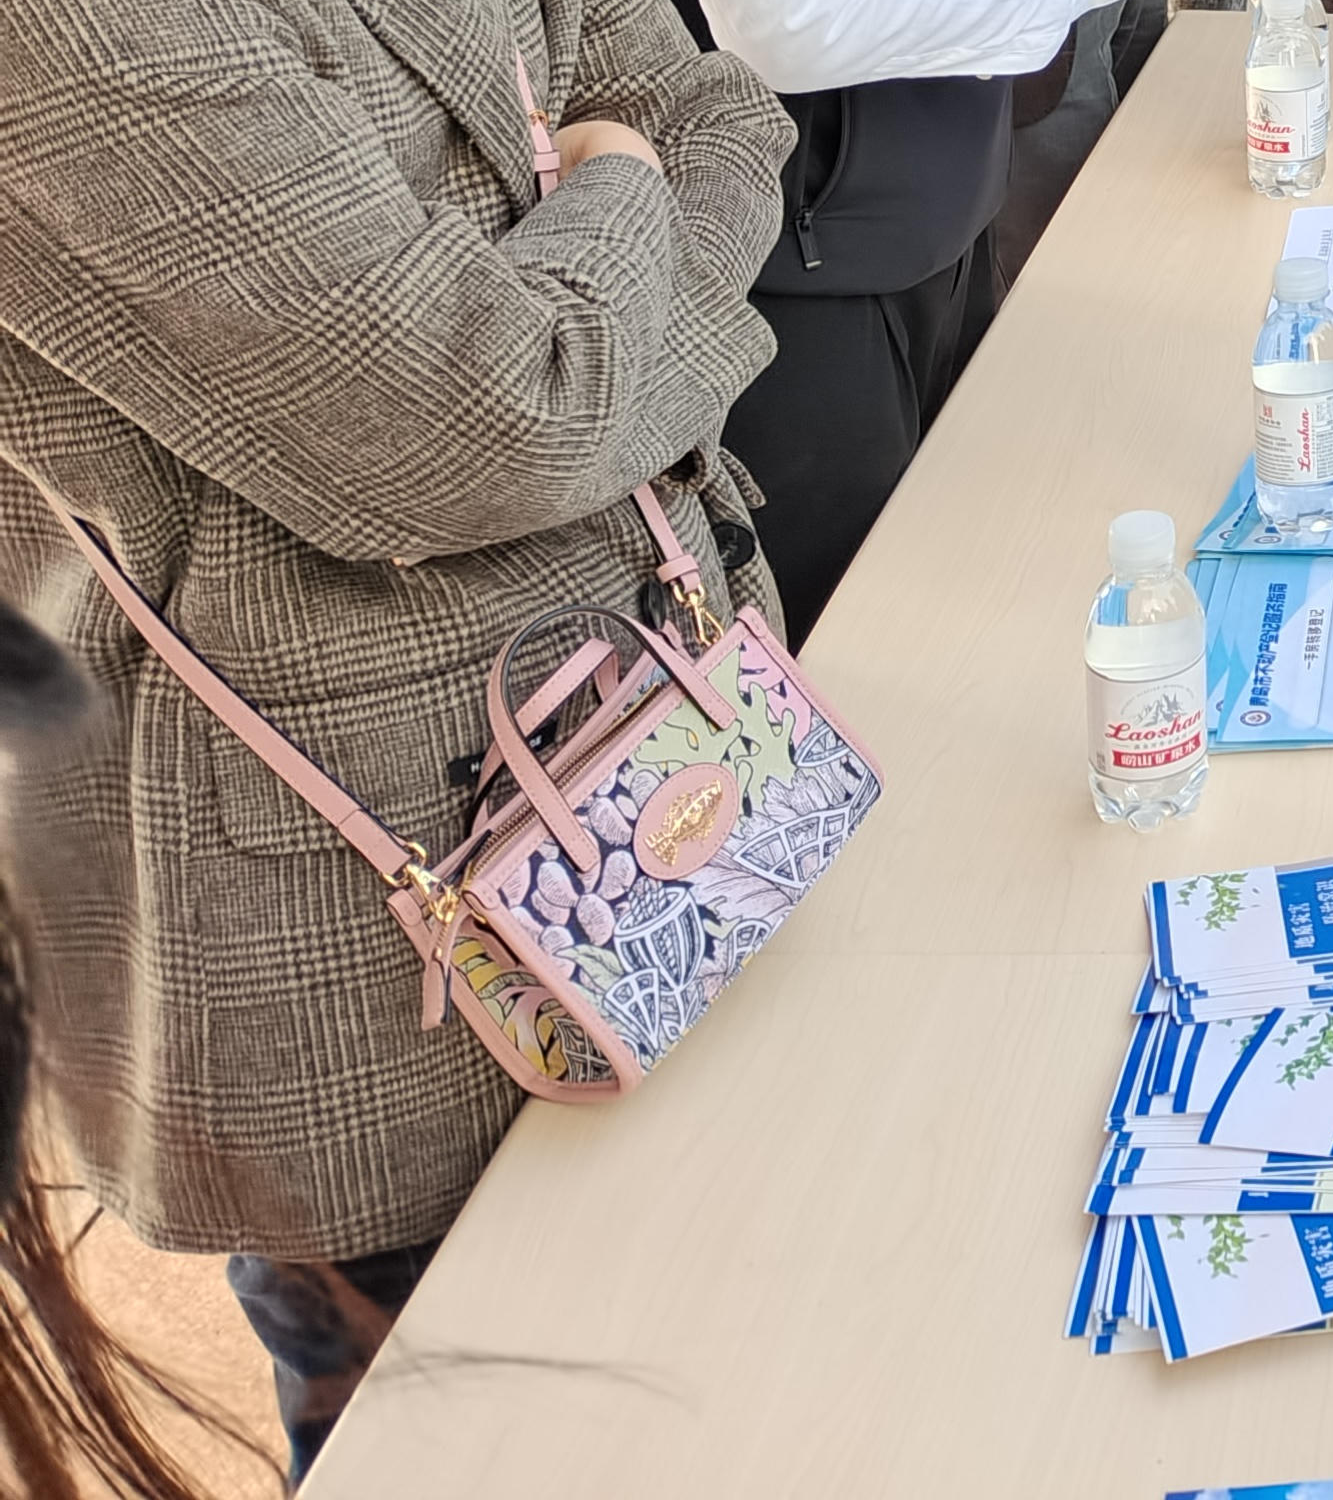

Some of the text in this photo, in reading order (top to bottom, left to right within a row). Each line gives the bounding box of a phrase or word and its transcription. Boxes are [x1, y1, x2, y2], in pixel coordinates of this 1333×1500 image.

[1296, 408, 1312, 473] Laoshan
[1249, 581, 1288, 707] 青岛市不动产登记服务指南
[1304, 608, 1325, 671] 一手房转移登记
[1105, 708, 1203, 742] Laoshan
[1120, 738, 1196, 767] 崂山矿泉水
[1293, 901, 1311, 950] 地质灾害
